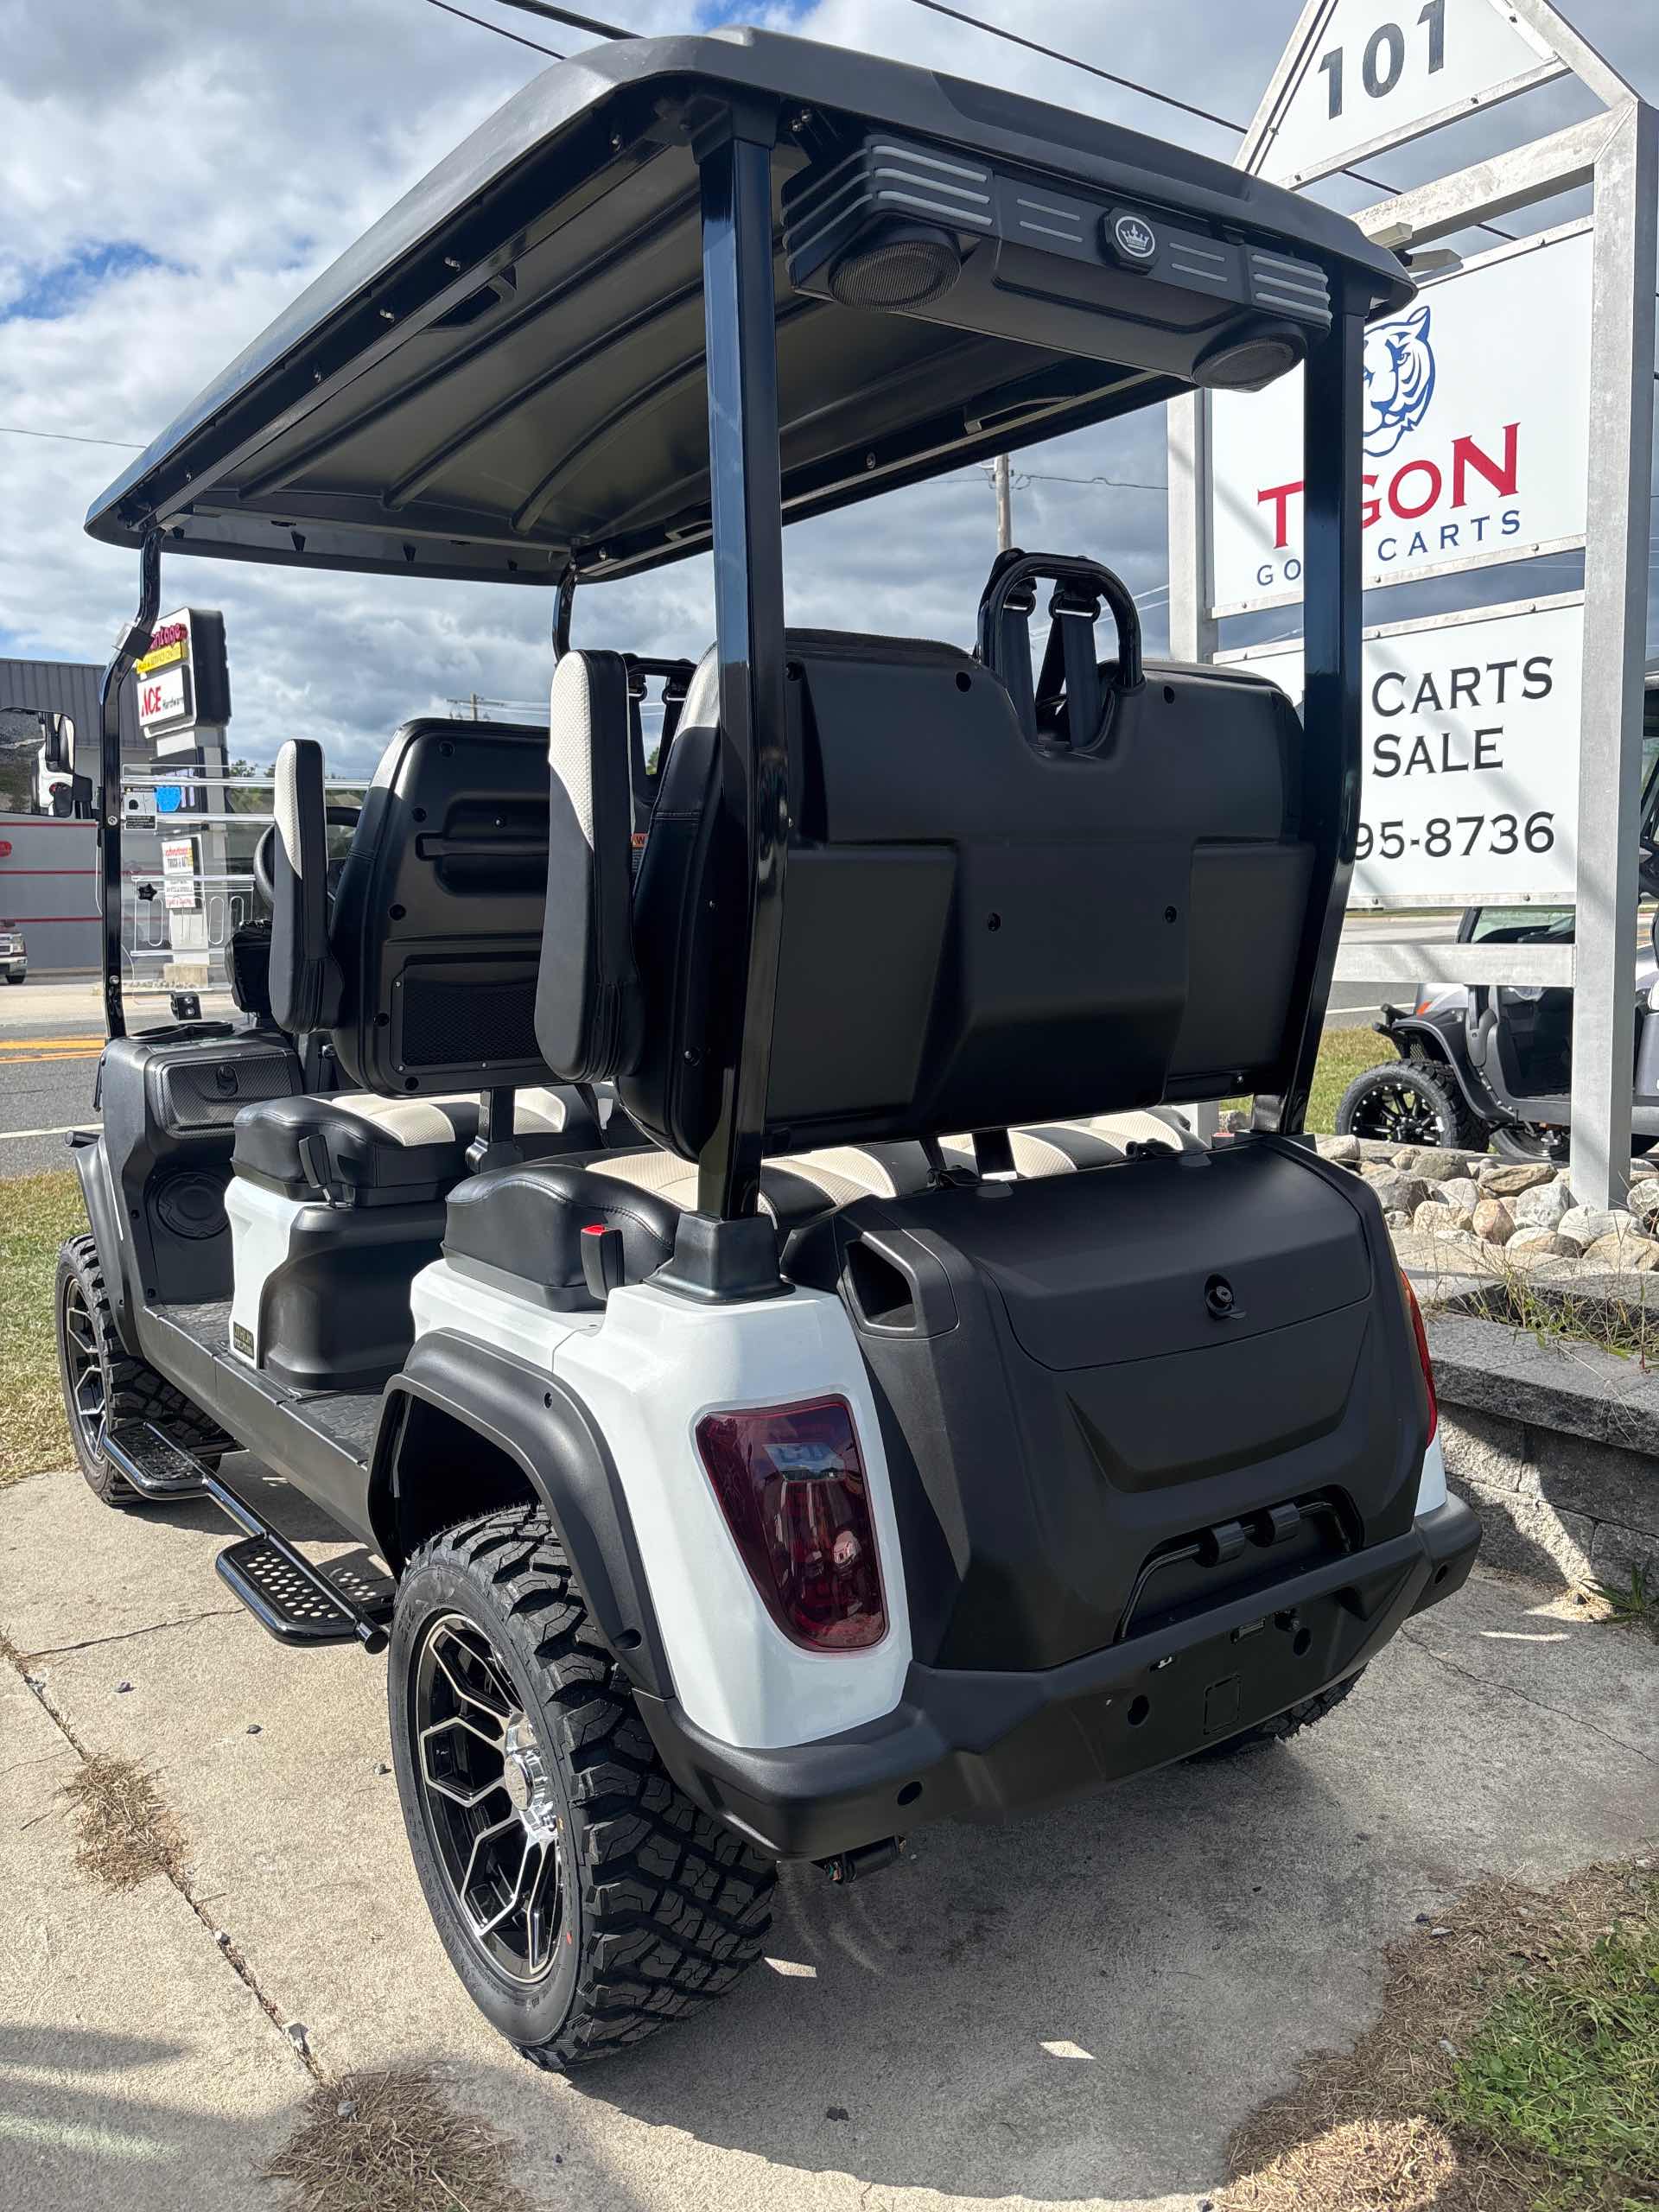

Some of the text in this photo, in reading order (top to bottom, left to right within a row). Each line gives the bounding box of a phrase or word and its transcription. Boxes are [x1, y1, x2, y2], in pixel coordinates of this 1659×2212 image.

[1318, 0, 1445, 120] 101
[1257, 422, 1521, 549] TGON
[1256, 510, 1521, 587] GO CARTS
[141, 686, 162, 717] ACE
[1372, 656, 1554, 717] CARTS
[1372, 725, 1504, 778] SALE
[1354, 811, 1555, 861] 95-8736
